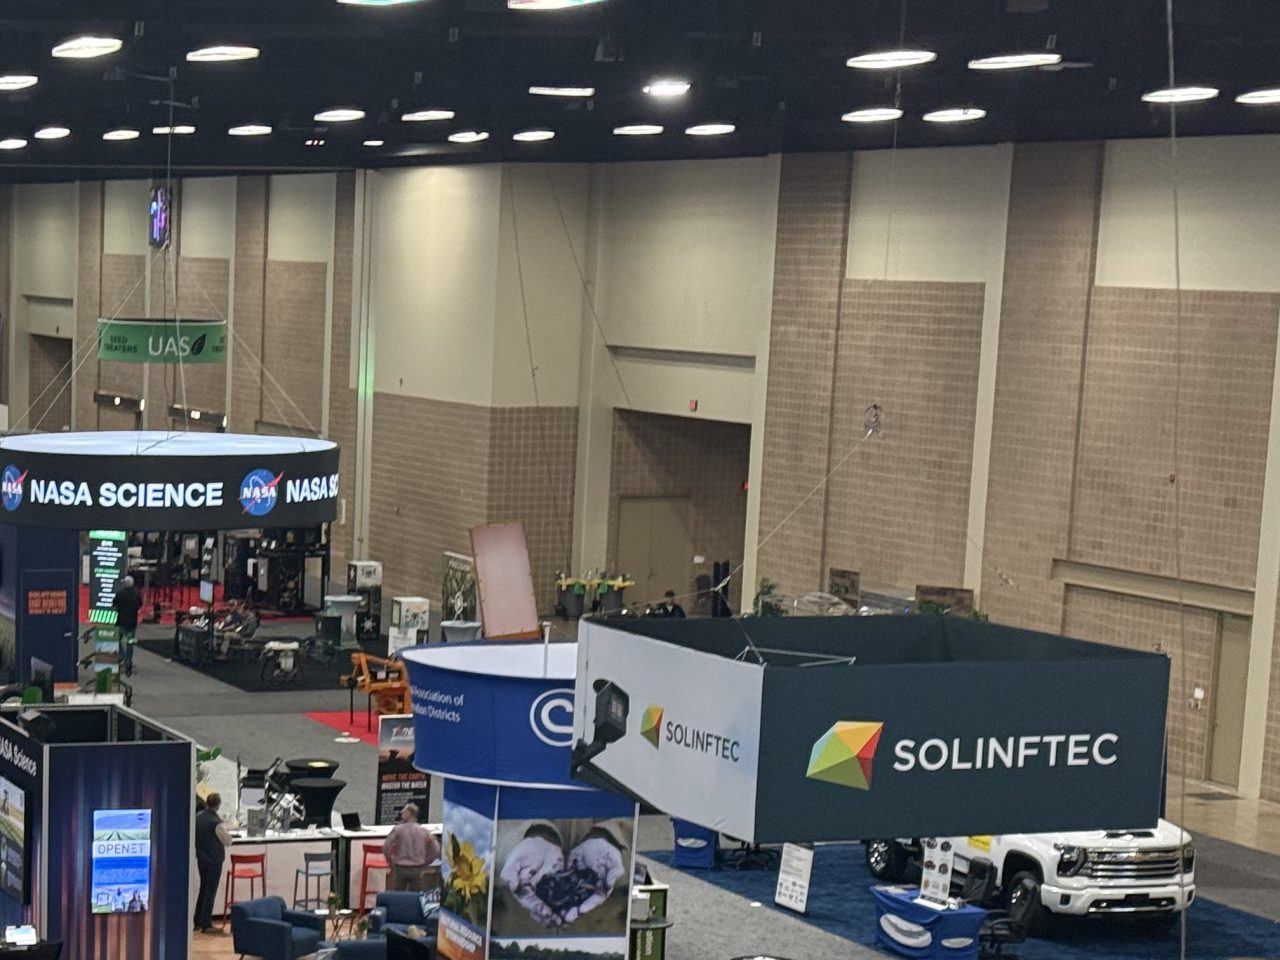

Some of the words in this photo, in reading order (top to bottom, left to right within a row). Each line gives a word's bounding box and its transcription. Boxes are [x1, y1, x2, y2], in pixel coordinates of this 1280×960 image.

[148, 336, 190, 356] UAS
[31, 479, 93, 506] NASA
[99, 482, 224, 508] SCIENCE
[242, 486, 277, 499] NASA
[286, 475, 328, 503] NASA
[453, 693, 465, 706] of
[665, 720, 740, 762] SOLINFTEC
[893, 732, 1119, 773] SOLINFTEC
[97, 843, 146, 855] OPENET
